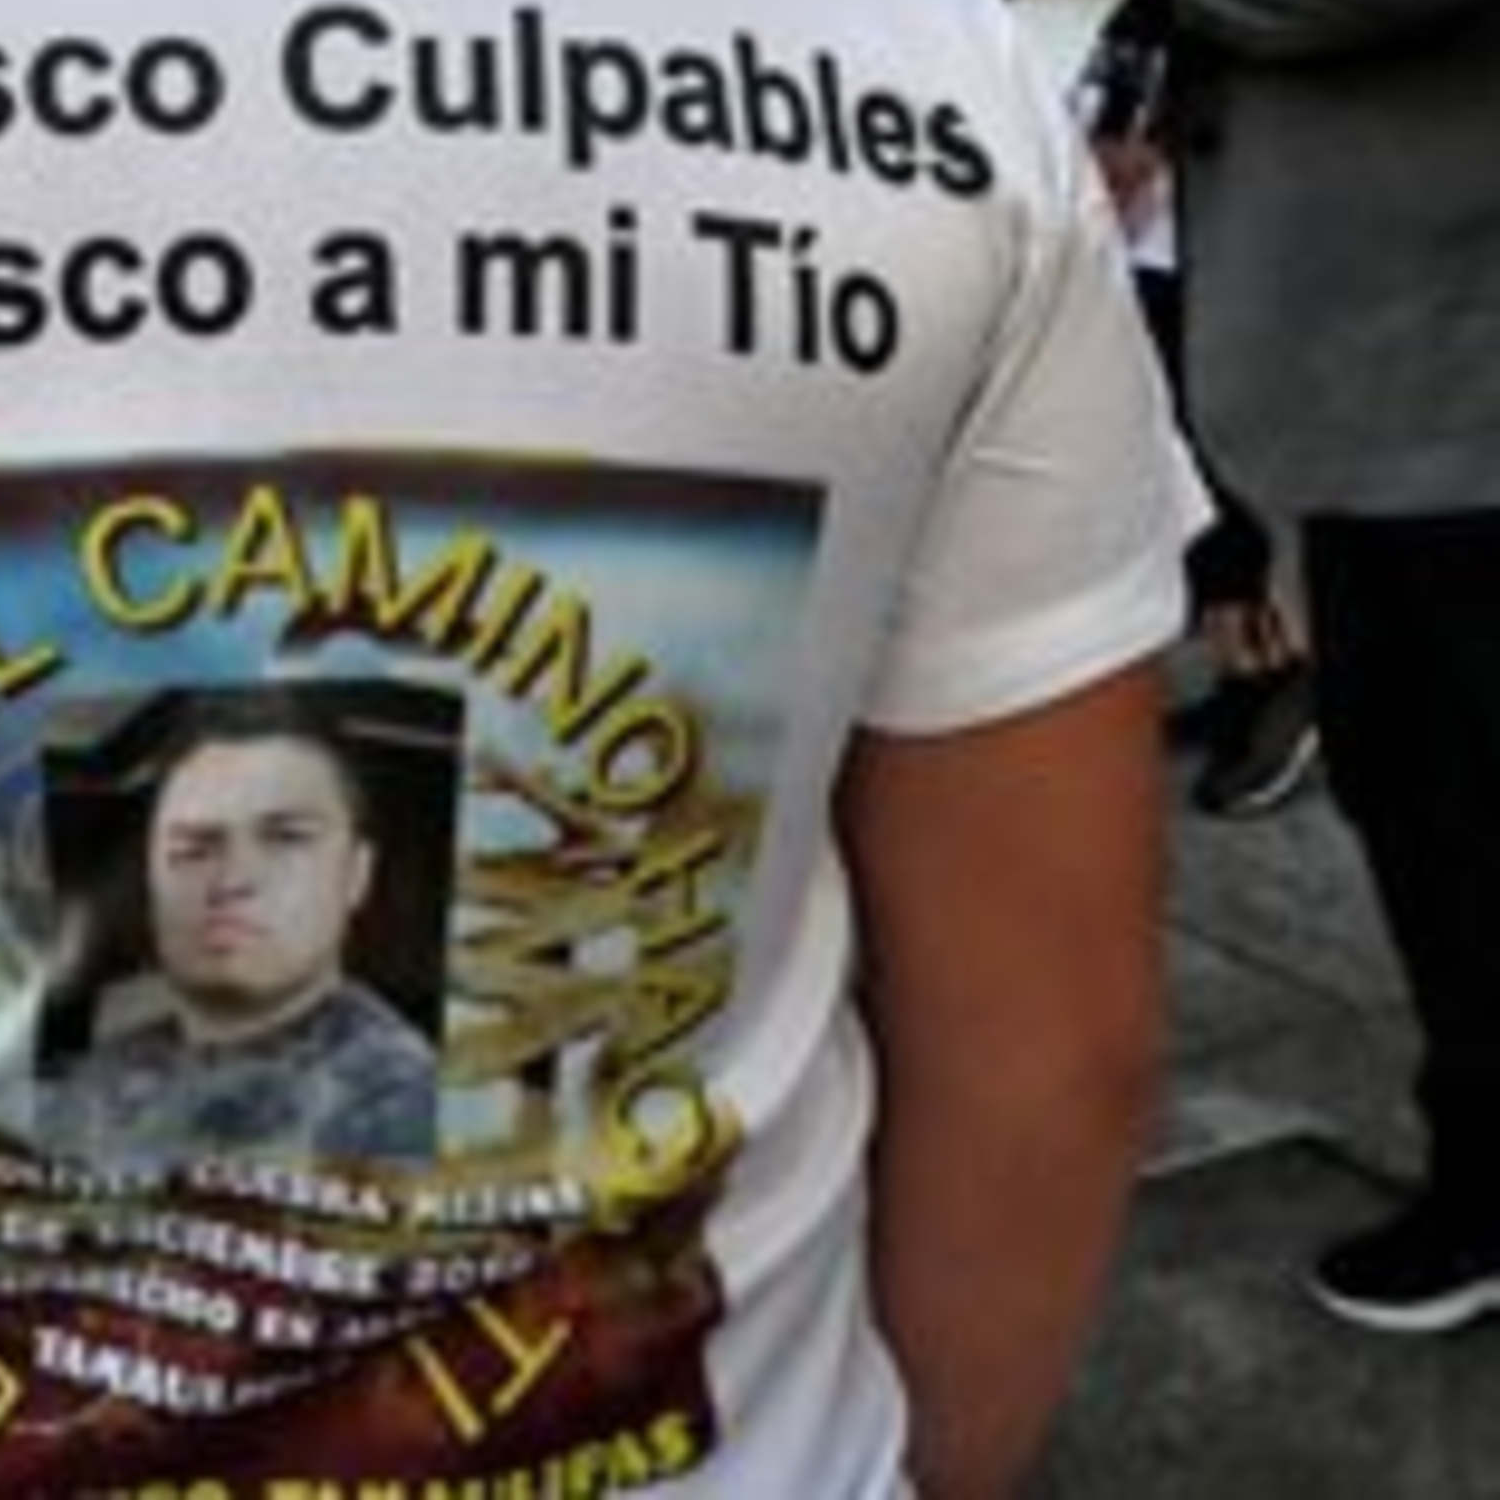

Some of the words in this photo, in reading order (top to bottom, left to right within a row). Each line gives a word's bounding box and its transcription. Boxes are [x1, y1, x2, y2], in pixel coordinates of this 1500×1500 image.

[280, 2, 995, 199] Culpables
[309, 228, 398, 336] a
[456, 204, 639, 344] mi
[690, 210, 900, 375] Tío
[80, 483, 700, 812] CAMINO
